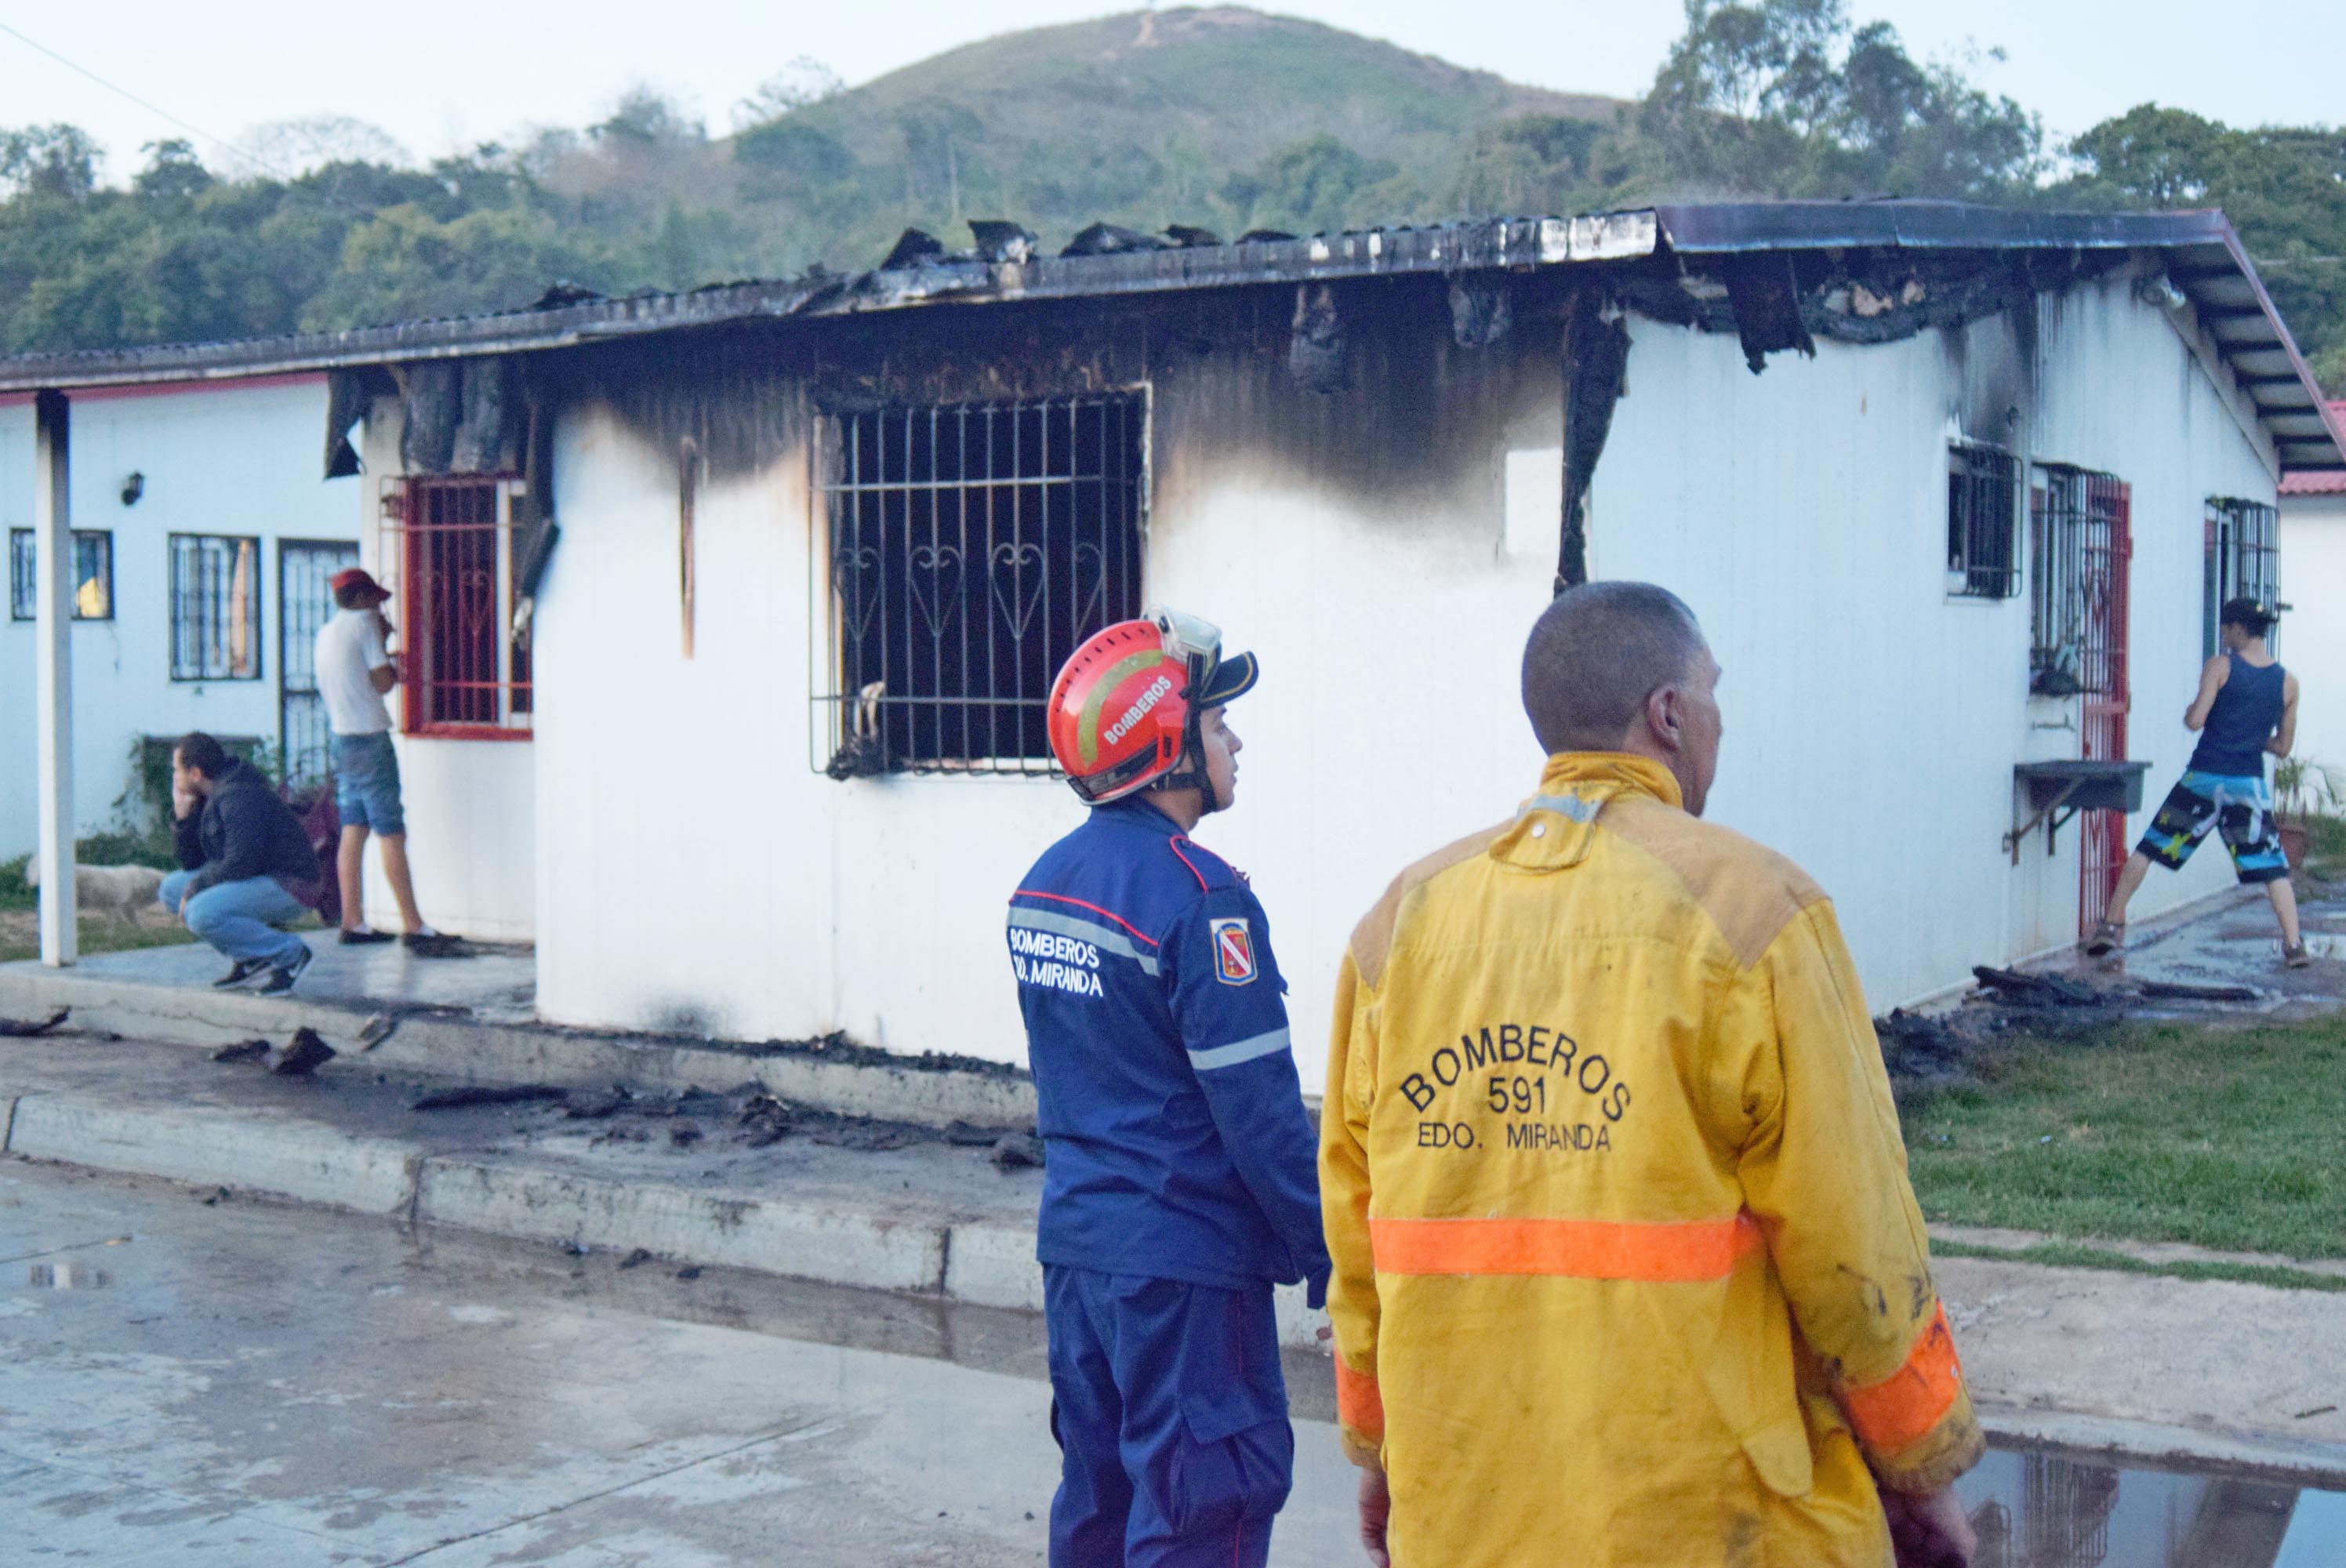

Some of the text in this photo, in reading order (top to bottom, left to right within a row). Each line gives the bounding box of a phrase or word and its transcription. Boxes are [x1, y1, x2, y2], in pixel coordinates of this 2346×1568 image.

[1103, 676, 1171, 745] BOMBEROS
[1010, 928, 1099, 968] BOMBEROS
[1030, 959, 1103, 997] MIRANDA
[1400, 1024, 1631, 1122] BOMBEROS
[1490, 1076, 1545, 1113] 591
[1417, 1122, 1611, 1150] EDO. MIRANDA
